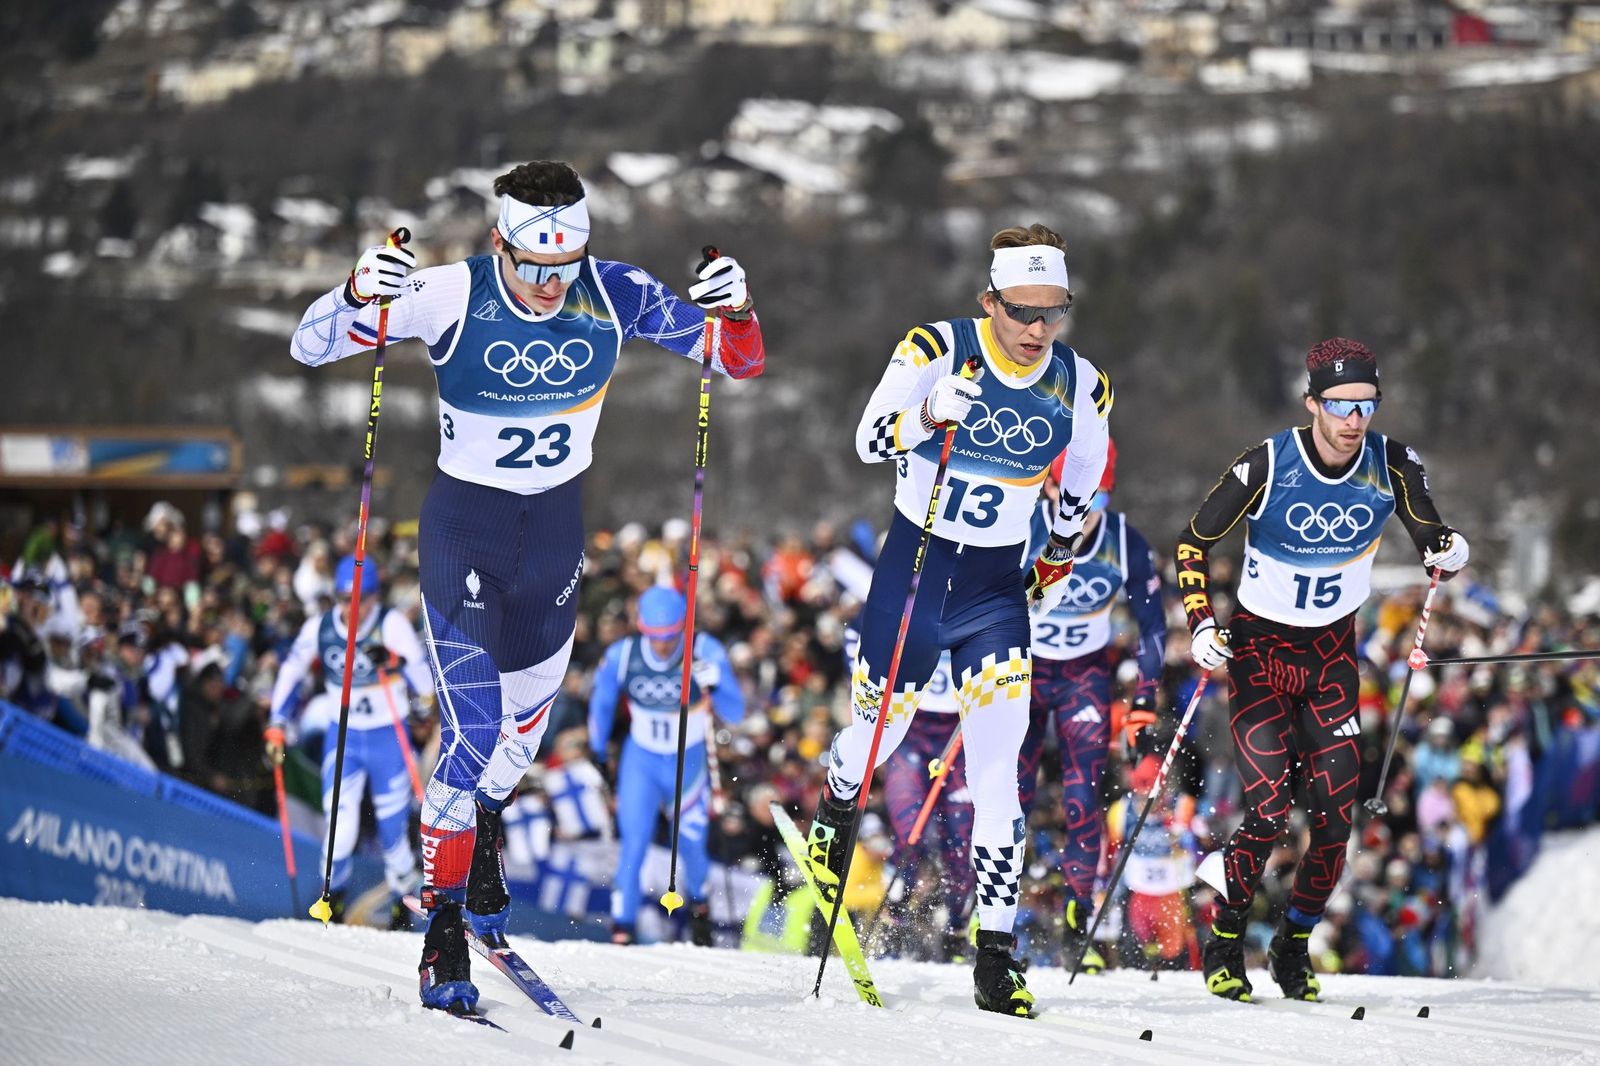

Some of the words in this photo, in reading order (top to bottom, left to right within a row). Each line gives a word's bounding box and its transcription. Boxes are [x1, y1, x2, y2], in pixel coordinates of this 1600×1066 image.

[371, 366, 384, 416] LEKI
[477, 391, 525, 402] MILANO
[527, 391, 575, 401] CORTINA
[577, 384, 596, 396] 2026
[698, 378, 710, 427] LEKI
[496, 423, 571, 468] 23
[982, 454, 1024, 470] CORTINA
[924, 484, 942, 532] LEKI
[943, 476, 1005, 529] 13
[1280, 542, 1315, 554] MILANO
[556, 558, 583, 606] CRAFT
[1178, 544, 1208, 614] GER
[1294, 572, 1342, 610] 15
[463, 600, 485, 610] FRANCE
[1036, 622, 1089, 648] 25
[996, 674, 1030, 686] CRAFT
[652, 718, 670, 742] 11
[6, 807, 122, 871] MILANO
[124, 836, 237, 905] CORTINA
